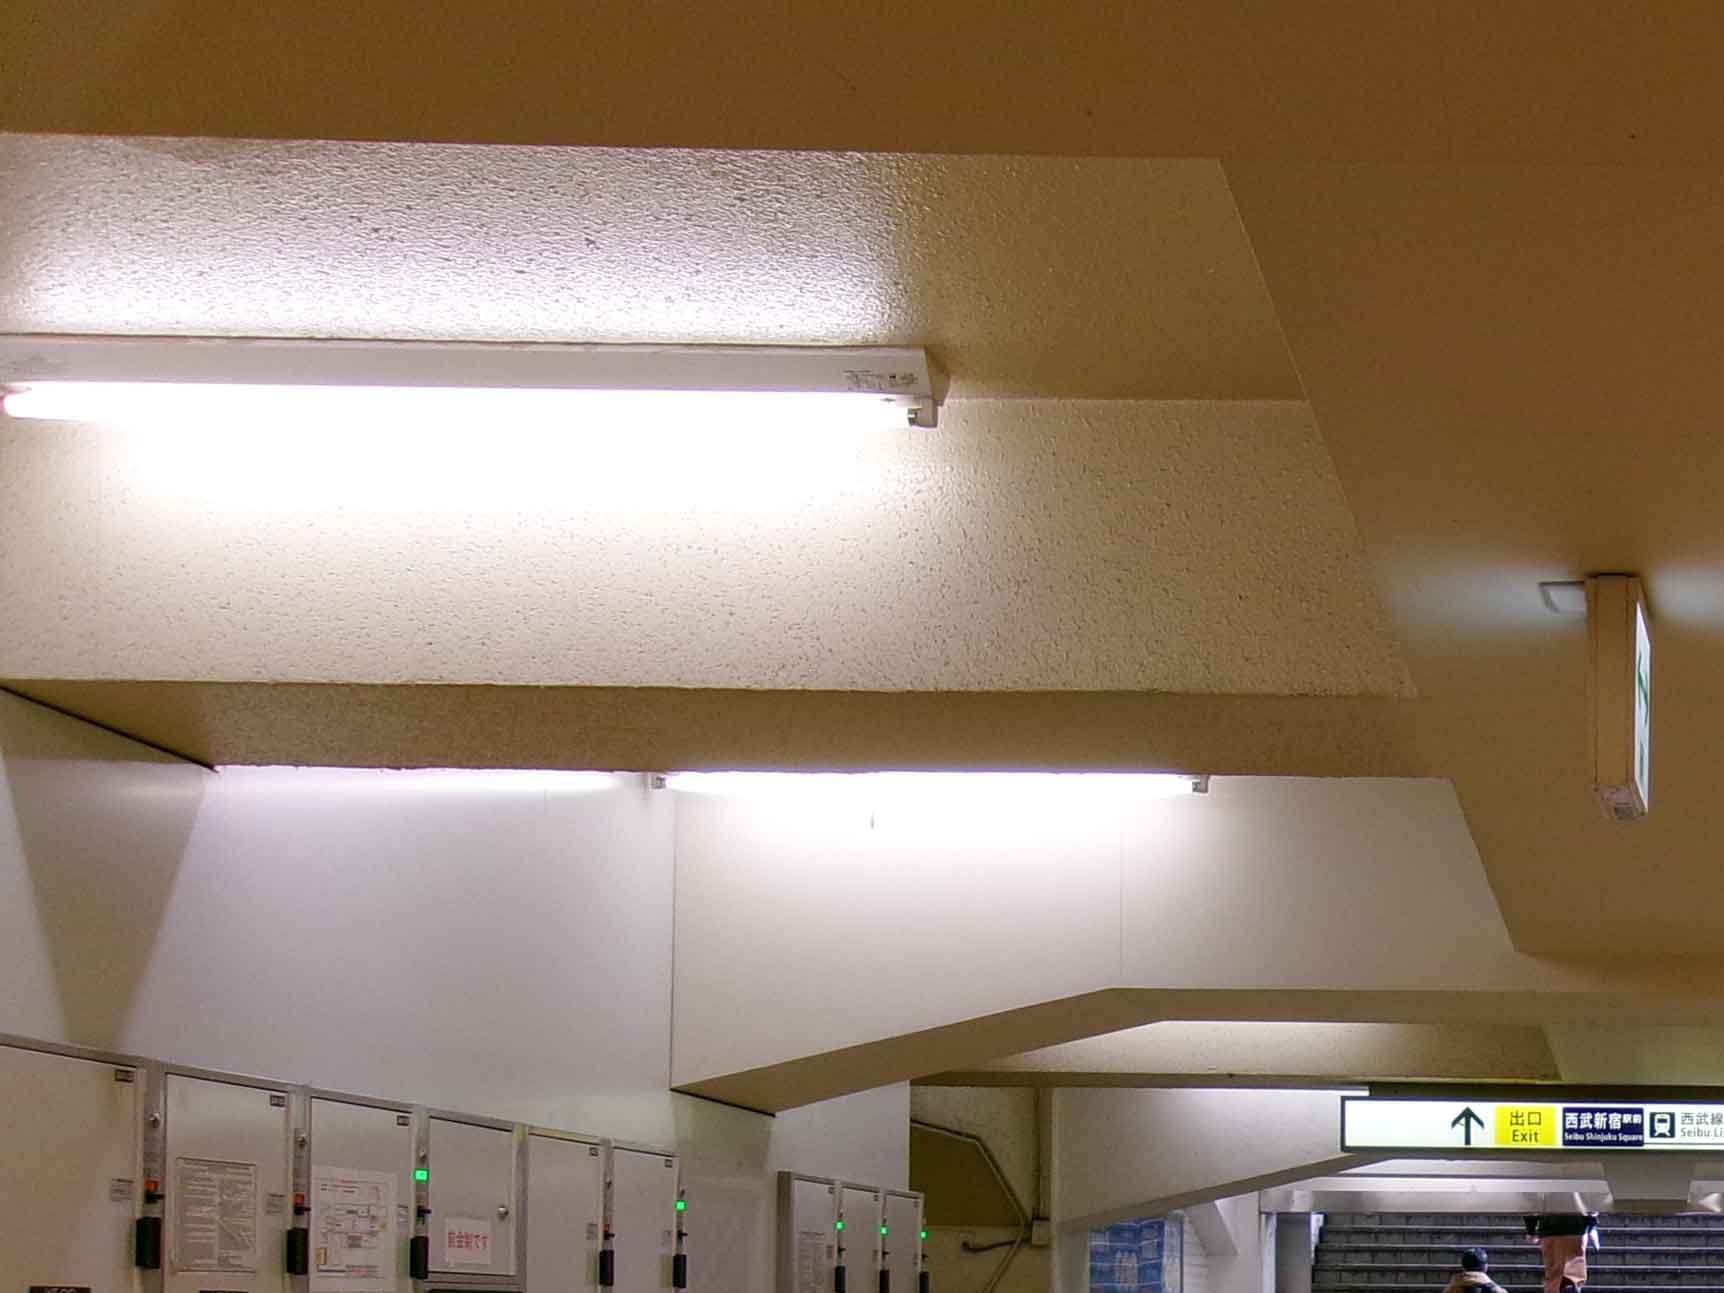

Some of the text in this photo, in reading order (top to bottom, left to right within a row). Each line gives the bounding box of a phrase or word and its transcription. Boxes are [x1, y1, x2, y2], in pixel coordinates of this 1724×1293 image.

[1510, 1110, 1541, 1126] 出口
[1680, 1111, 1723, 1125] 西武線
[1512, 1129, 1539, 1142] Exit
[1564, 1132, 1585, 1141] Seibu
[1680, 1127, 1711, 1137] Seibu
